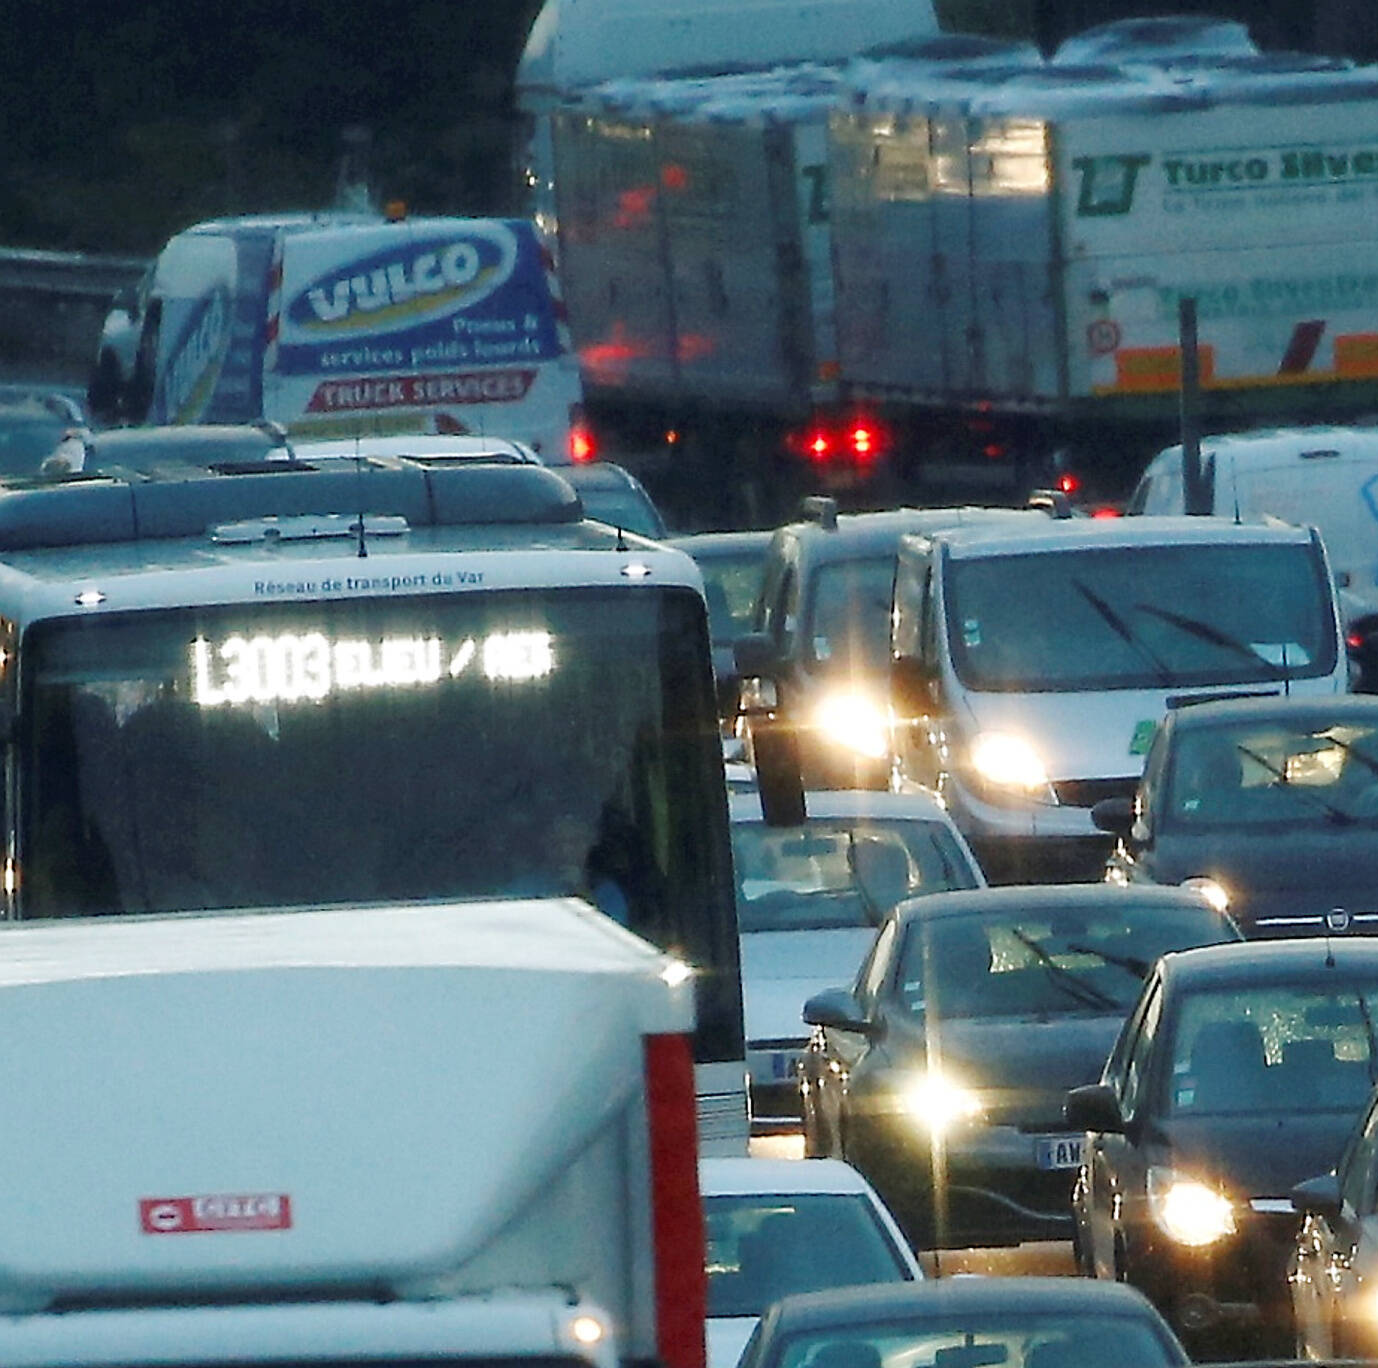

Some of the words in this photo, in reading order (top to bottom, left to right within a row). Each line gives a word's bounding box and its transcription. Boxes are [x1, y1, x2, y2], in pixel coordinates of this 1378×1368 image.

[1162, 157, 1268, 185] Turco
[307, 242, 480, 321] VULCO
[324, 380, 404, 403] TRUCK
[413, 371, 524, 399] SERVICES
[254, 579, 317, 596] Réseau
[321, 577, 342, 592] de
[346, 573, 427, 591] transport
[431, 571, 452, 586] du
[456, 570, 485, 585] Var
